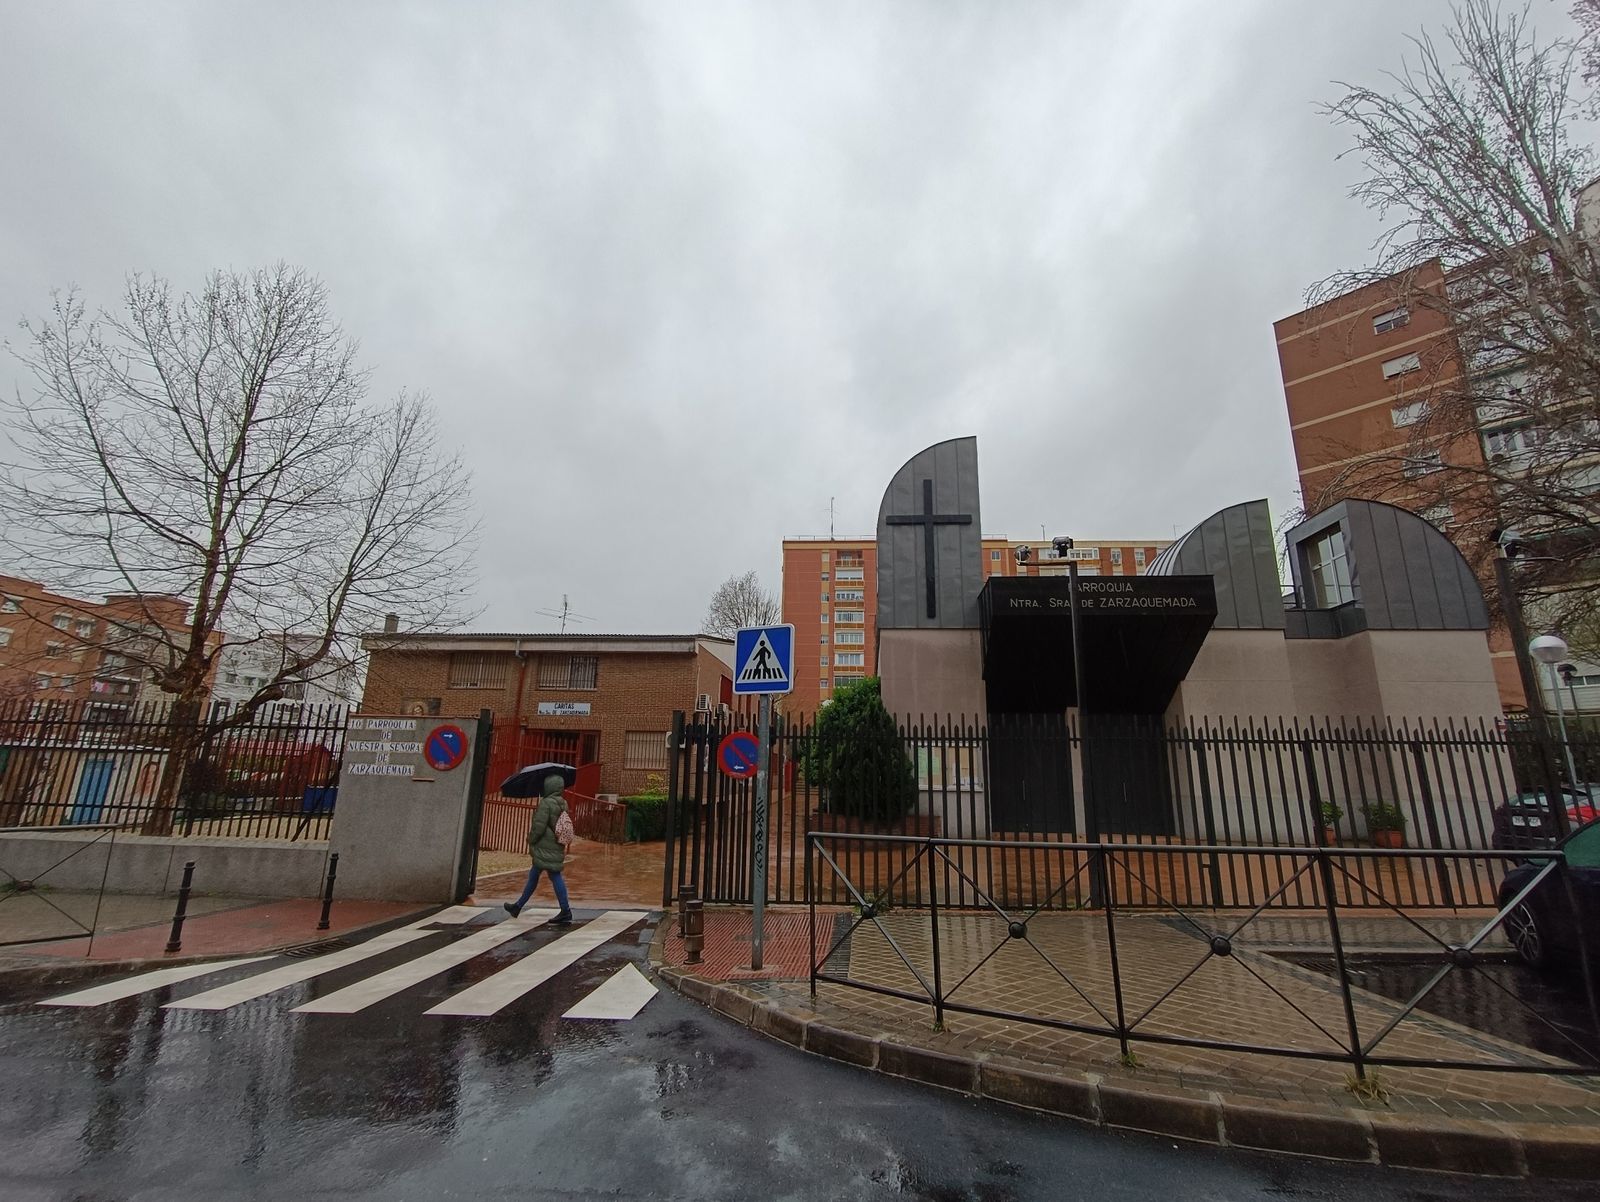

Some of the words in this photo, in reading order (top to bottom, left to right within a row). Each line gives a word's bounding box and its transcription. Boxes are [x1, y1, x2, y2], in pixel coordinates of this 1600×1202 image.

[1067, 582, 1134, 594] ARROQUIA
[1099, 597, 1197, 608] ZARZAQUEMADA
[367, 719, 414, 729] PARROQUIA
[381, 731, 391, 740] DE
[349, 742, 384, 751] NUESTRA
[377, 754, 388, 762] DE
[349, 764, 413, 775] ZARZAQUEMADA
